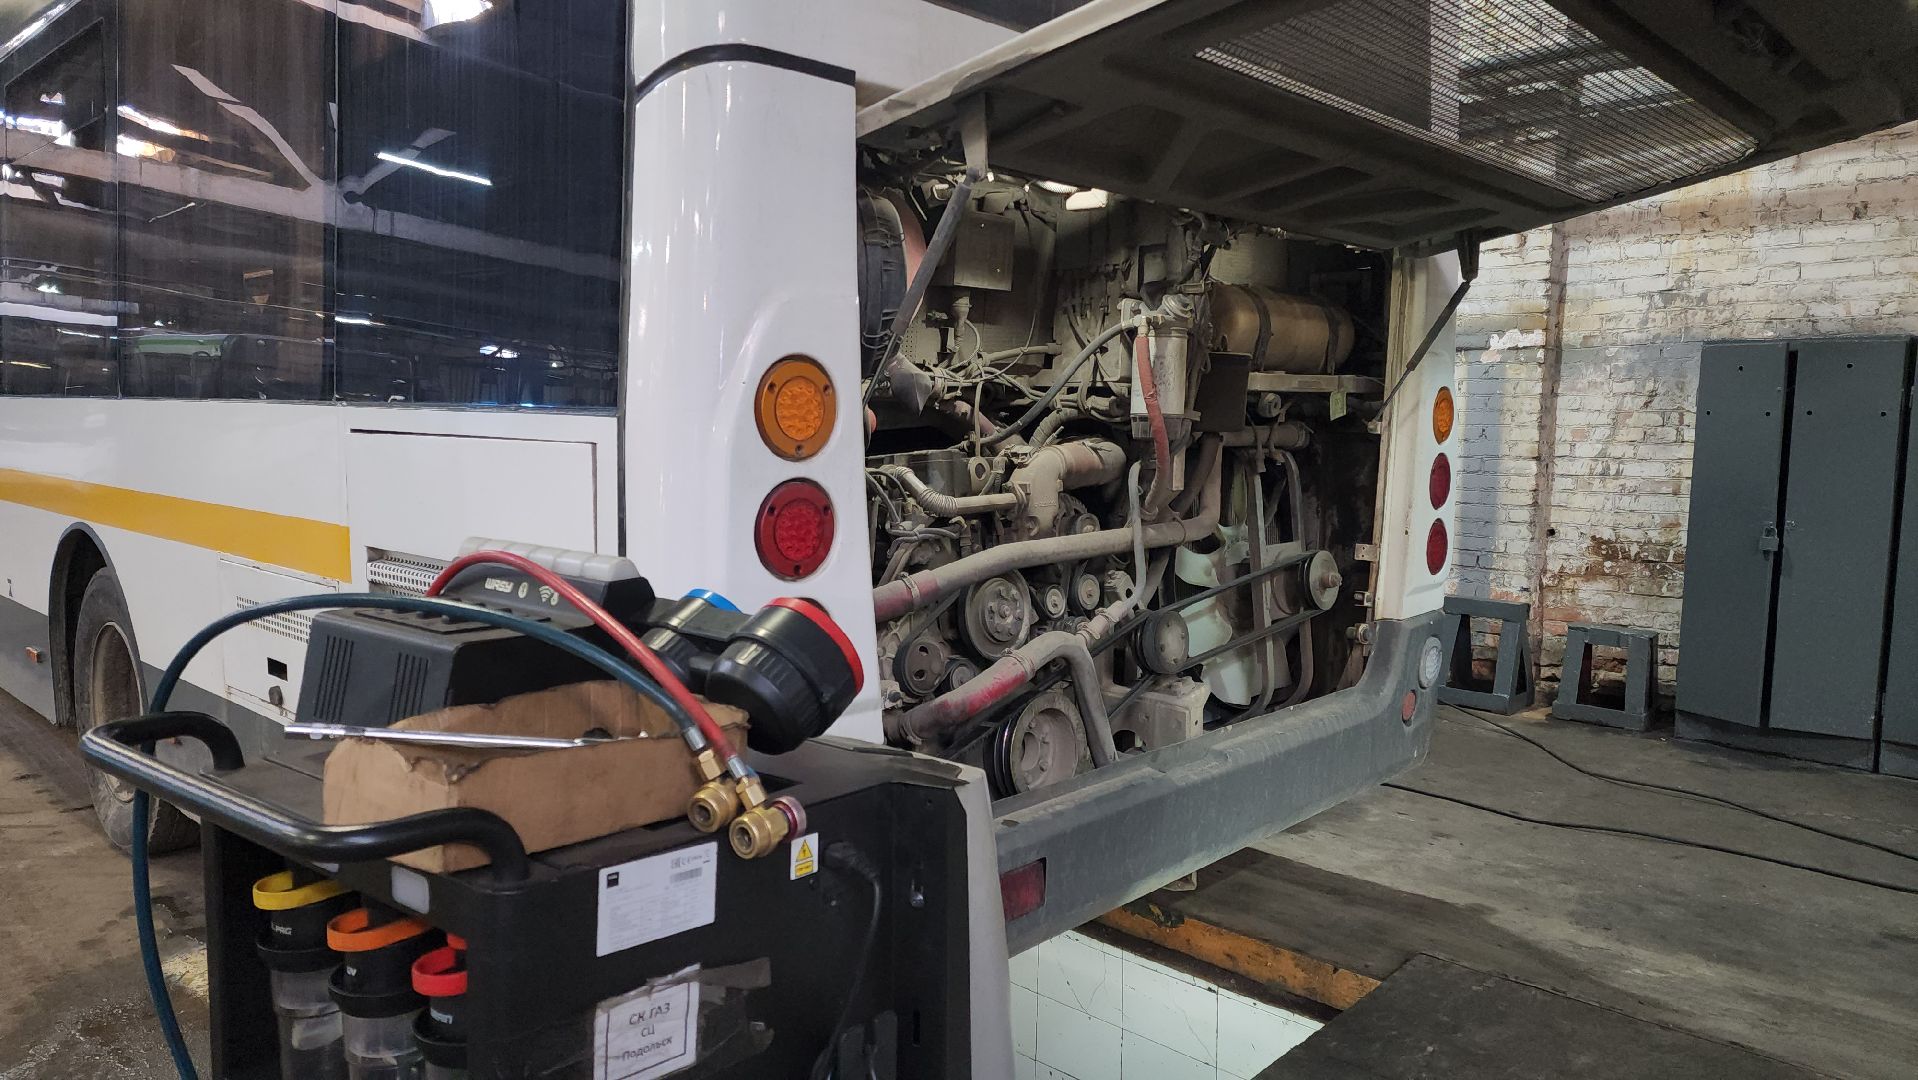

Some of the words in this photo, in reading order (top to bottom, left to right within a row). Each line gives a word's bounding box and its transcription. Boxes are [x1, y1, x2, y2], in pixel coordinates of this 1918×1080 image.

[629, 1010, 646, 1025] СК
[649, 1002, 670, 1018] ГАЗ
[641, 1024, 655, 1037] СЦ
[622, 1036, 672, 1060] Подольск
